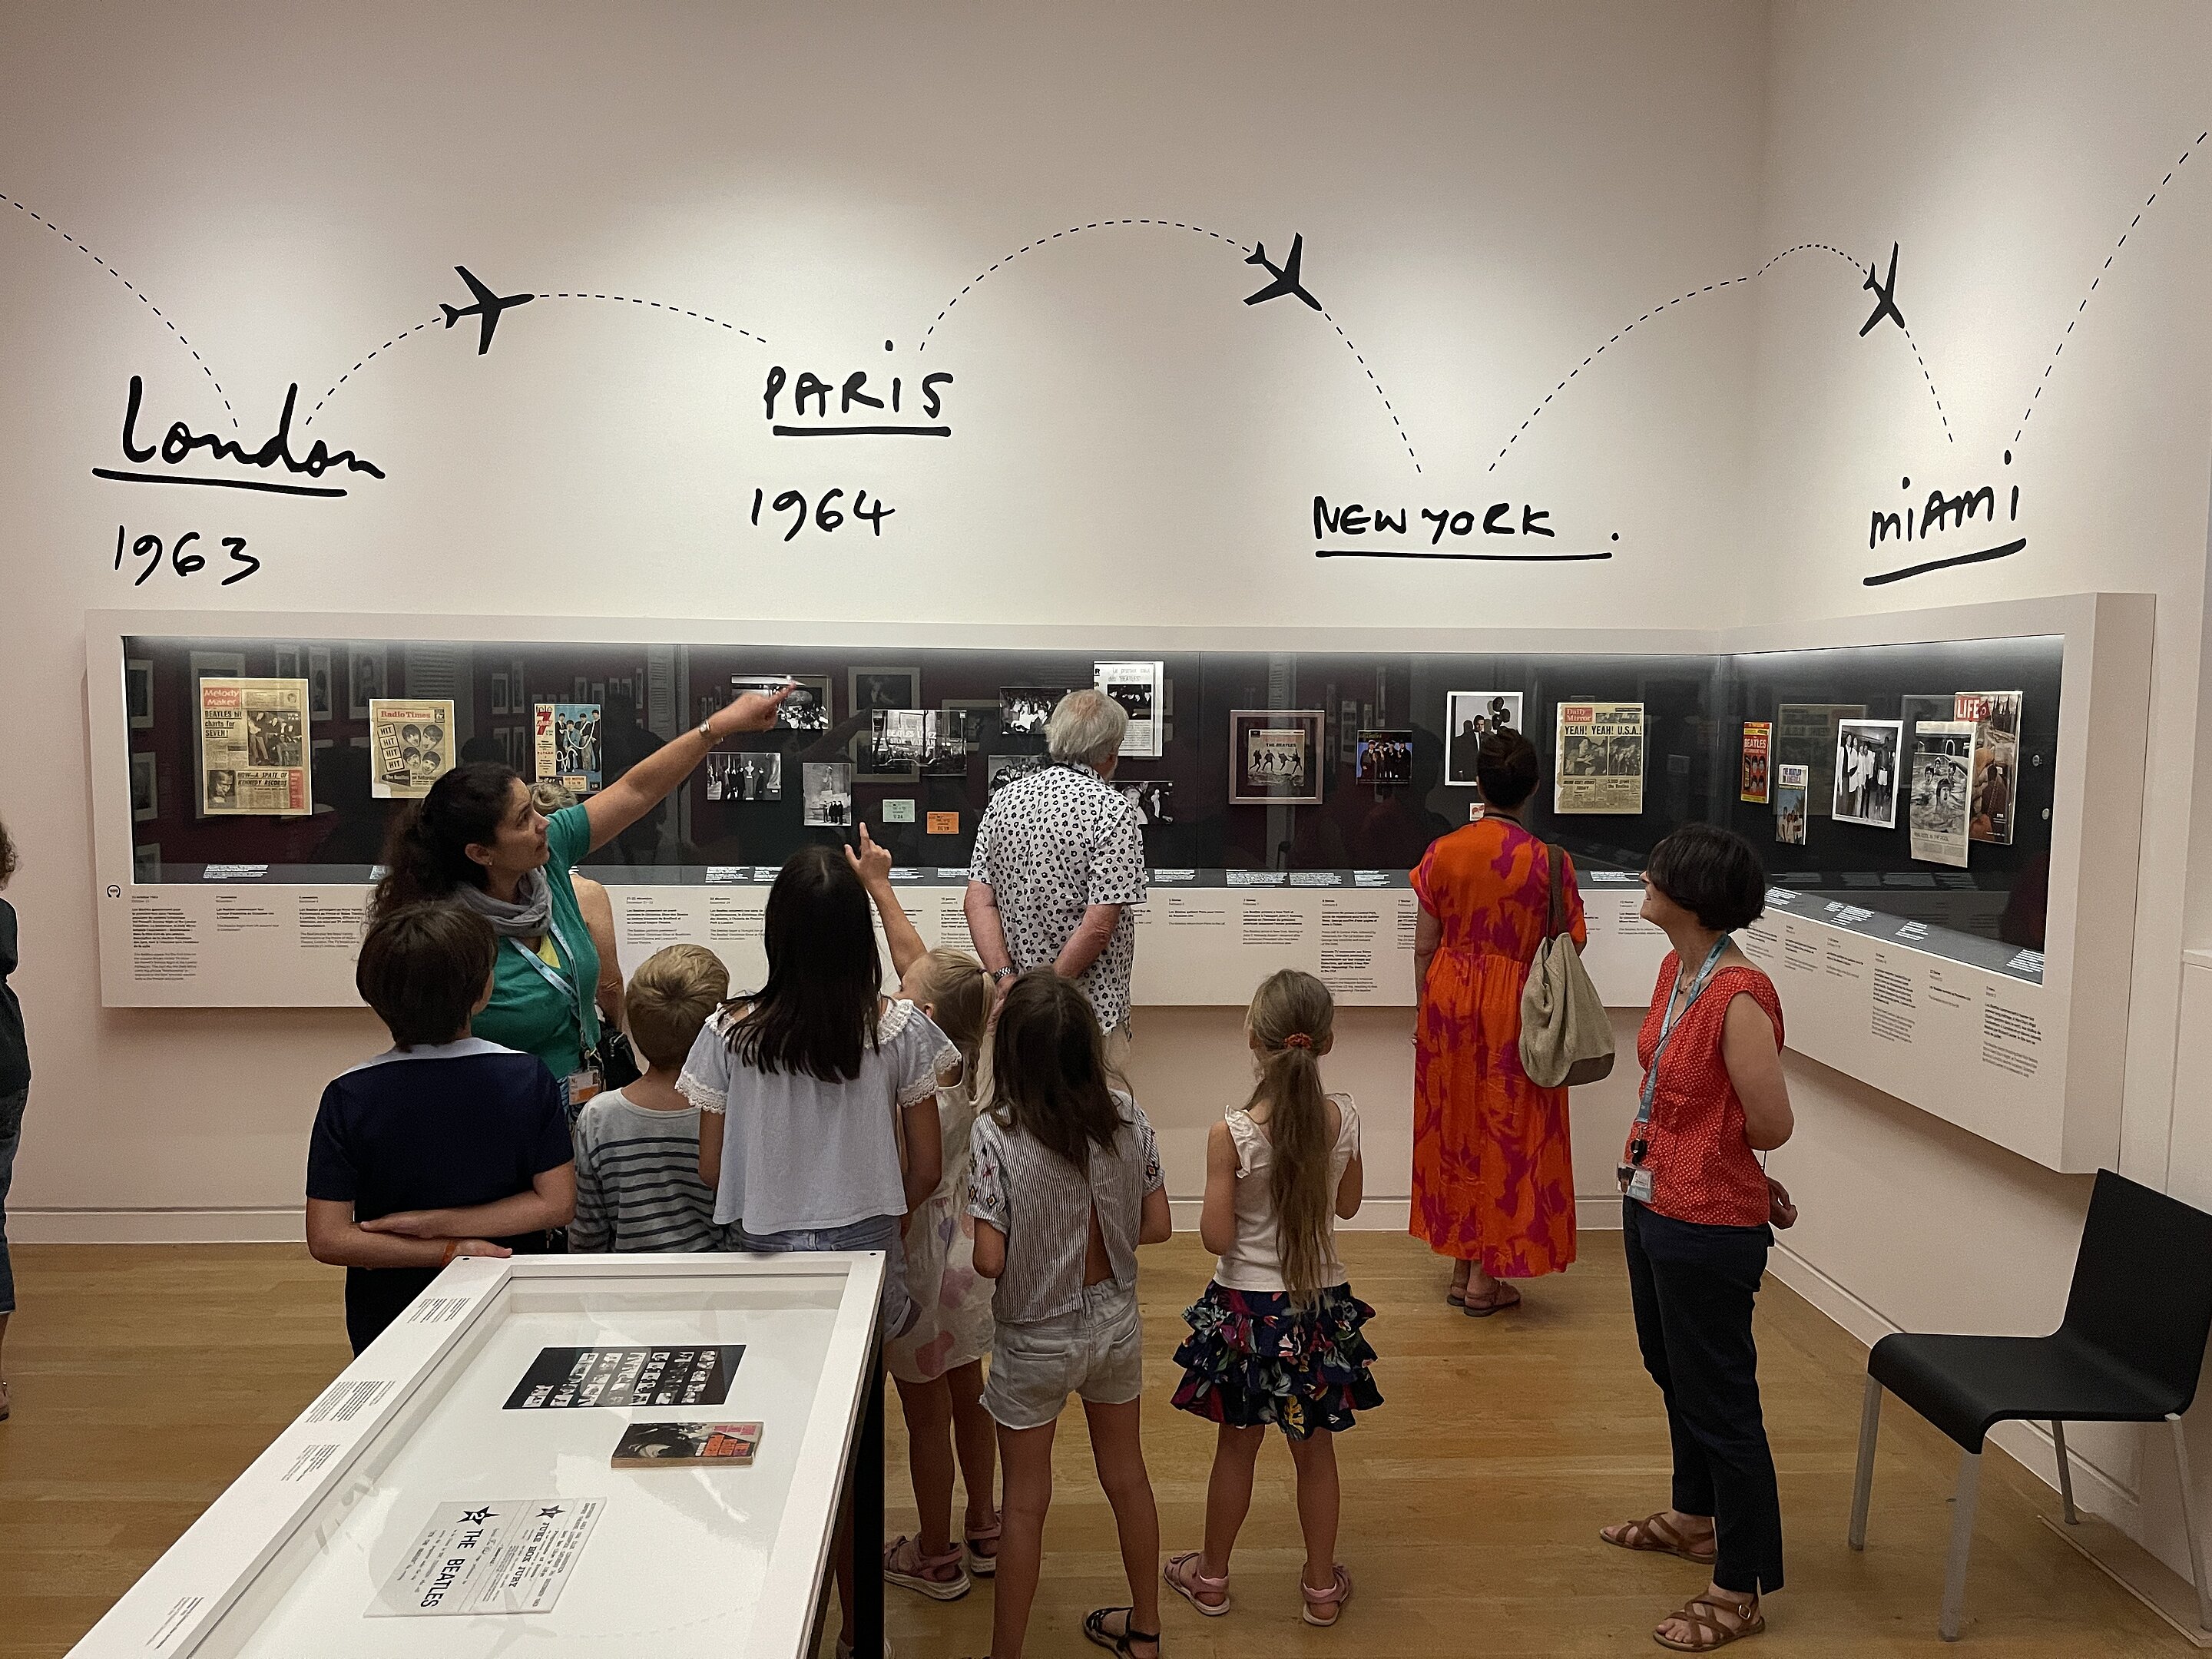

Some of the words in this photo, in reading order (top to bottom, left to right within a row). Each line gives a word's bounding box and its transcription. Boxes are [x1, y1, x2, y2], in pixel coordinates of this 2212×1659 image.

[123, 376, 385, 478] London
[752, 488, 895, 541] 1964
[1314, 496, 1406, 539] NEW
[1422, 503, 1555, 545] YORK
[115, 525, 260, 585] 1963
[204, 689, 239, 697] Melody
[207, 697, 237, 706] Maker
[381, 710, 406, 719] Radio
[1958, 699, 1980, 719] LIFE
[1565, 725, 1588, 735] YEAH!
[1591, 725, 1614, 735] YEAH!
[1618, 725, 1642, 735] U.S.A.!
[386, 749, 398, 757] HIT
[1744, 739, 1767, 749] BEATLES
[469, 1512, 485, 1521] 2
[457, 1528, 484, 1549] THE
[522, 1545, 537, 1563] BOX
[420, 1558, 465, 1608] BEATLES
